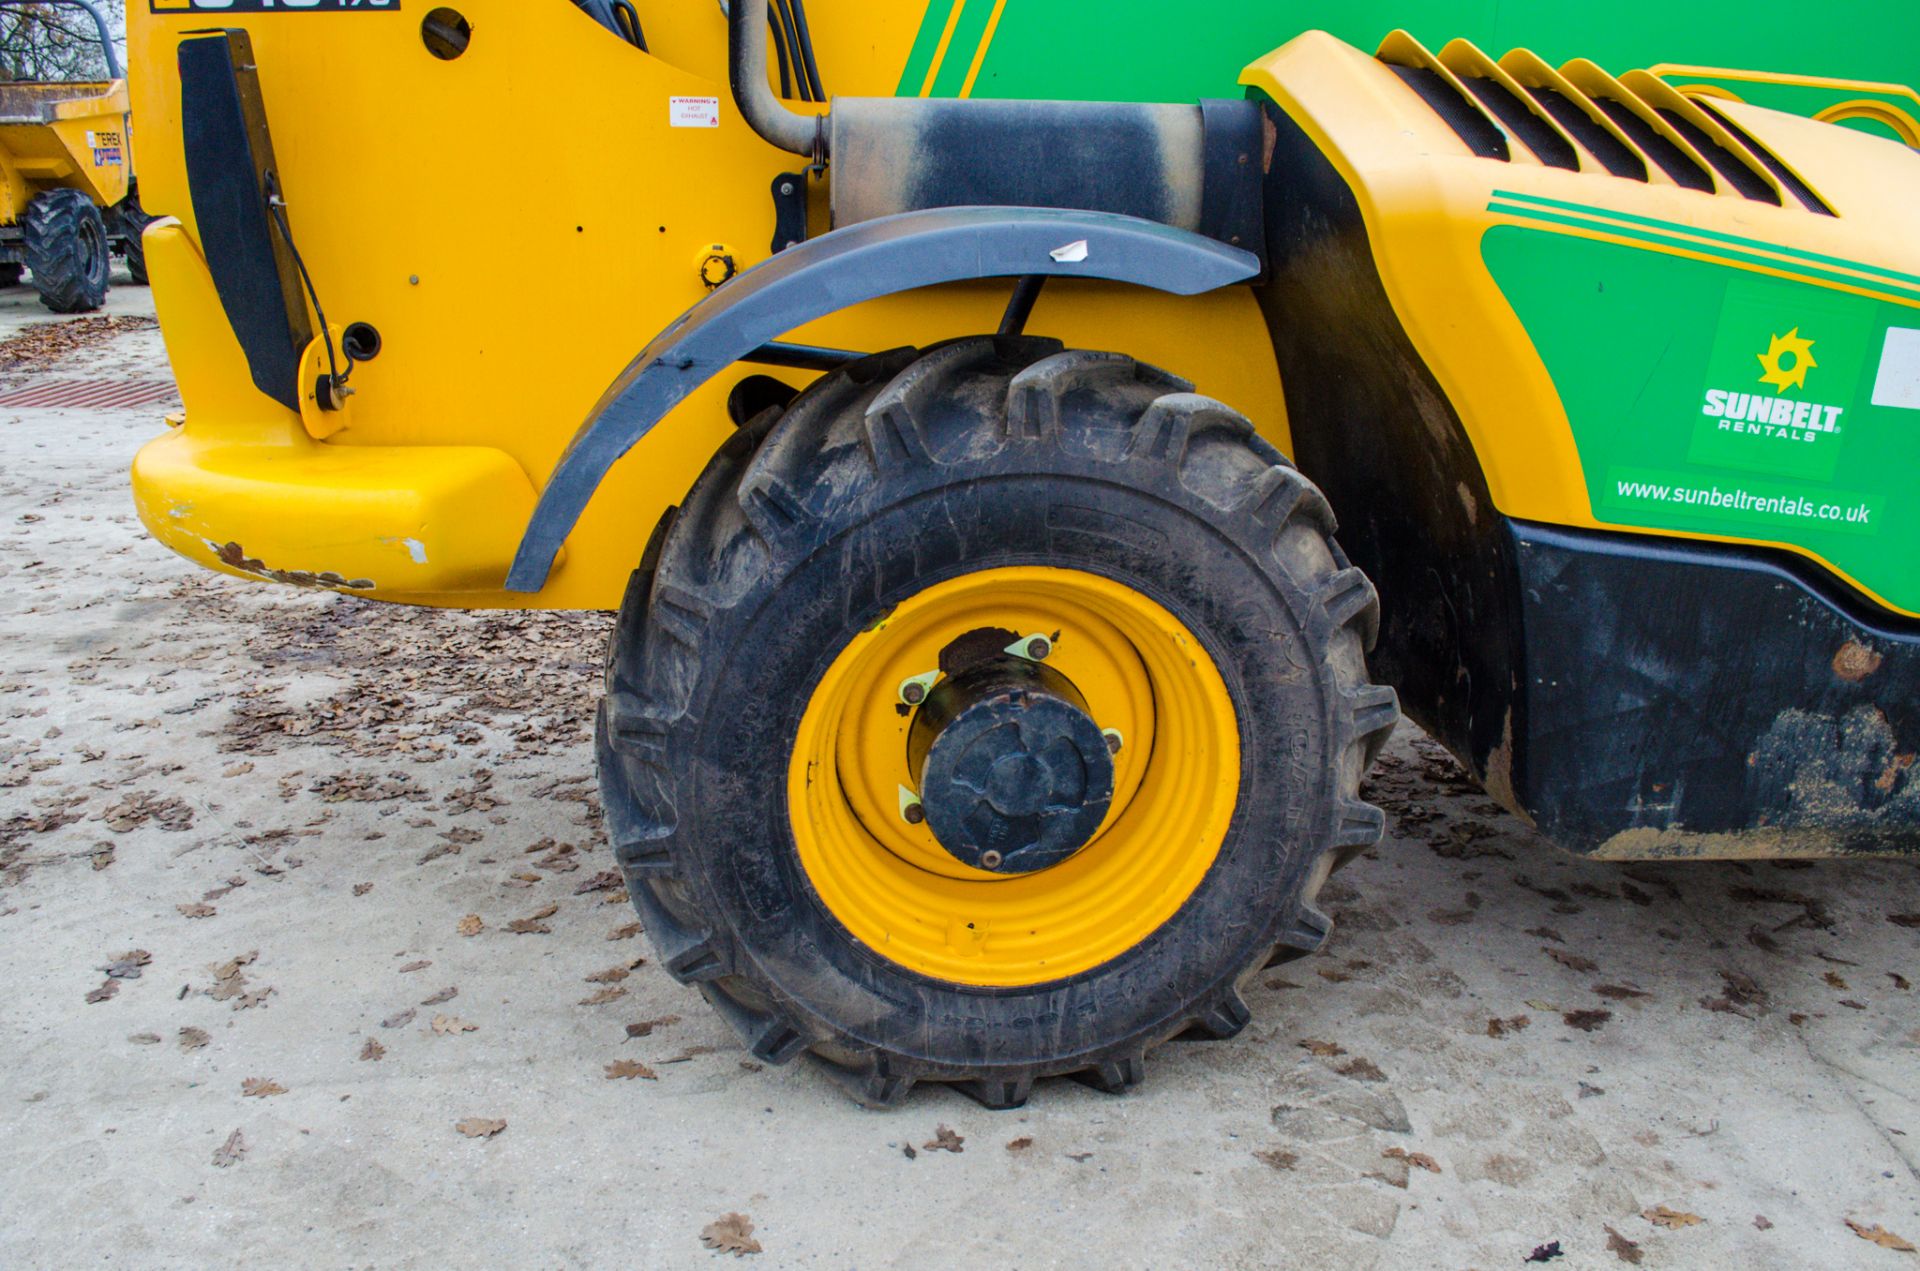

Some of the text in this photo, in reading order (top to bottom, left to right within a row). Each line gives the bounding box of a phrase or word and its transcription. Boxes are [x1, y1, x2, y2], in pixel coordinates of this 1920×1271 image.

[1702, 388, 1844, 433] SUNBELT
[1718, 419, 1816, 442] RENTALS
[1617, 480, 1870, 523] www.sunbeltrentals.co.uk
